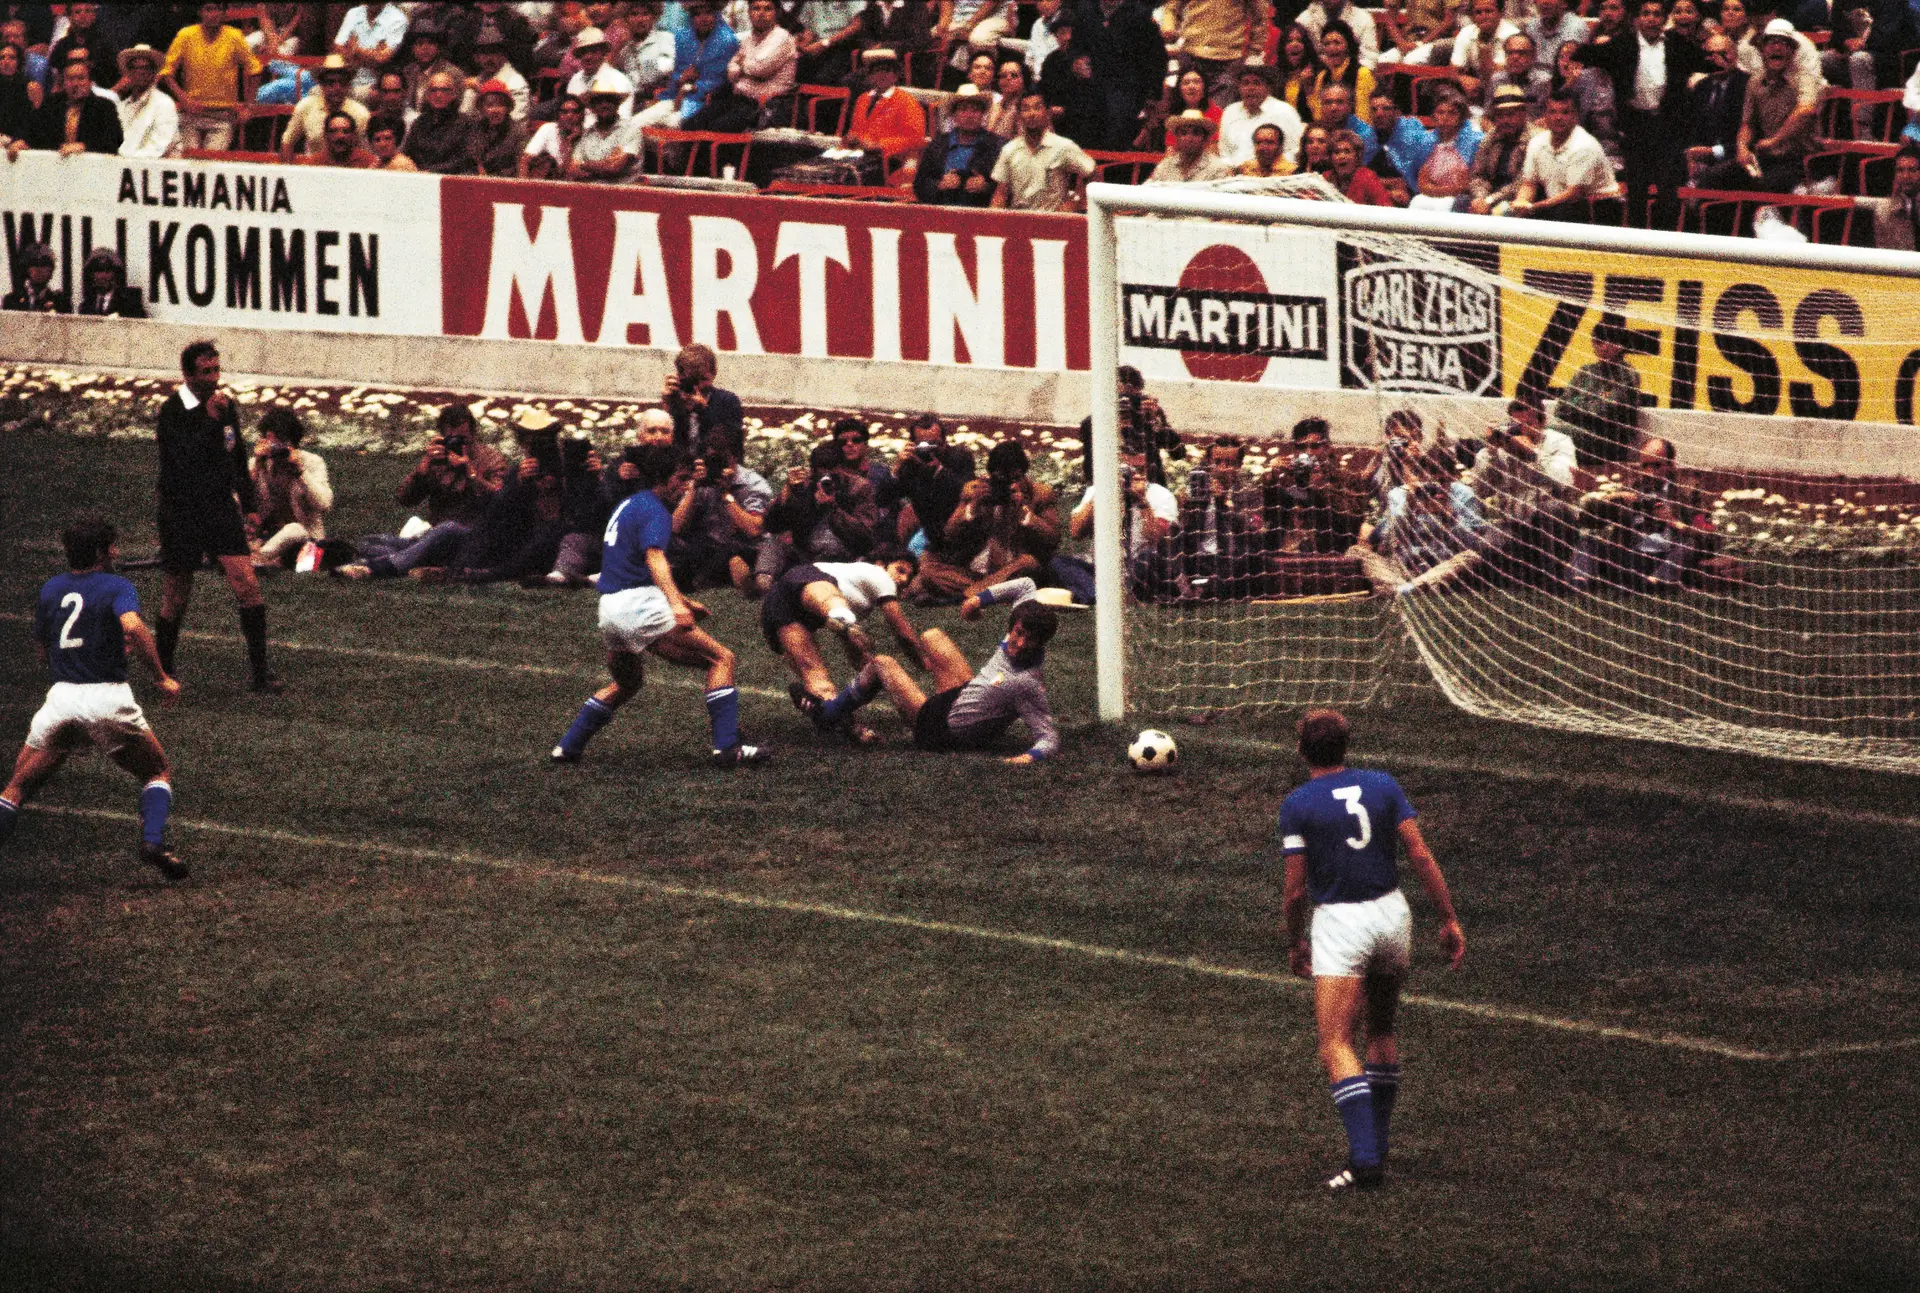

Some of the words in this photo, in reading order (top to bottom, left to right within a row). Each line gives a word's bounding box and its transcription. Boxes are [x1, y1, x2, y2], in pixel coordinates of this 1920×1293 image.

[118, 168, 293, 213] ALEMANIA
[480, 202, 1069, 371] MARTINI
[1356, 272, 1422, 330] CARL
[1130, 294, 1319, 351] MARTINI
[1515, 268, 1865, 420] ZEISS
[1374, 341, 1467, 391] JENA
[59, 592, 83, 649] 2
[1332, 785, 1372, 849] 3
